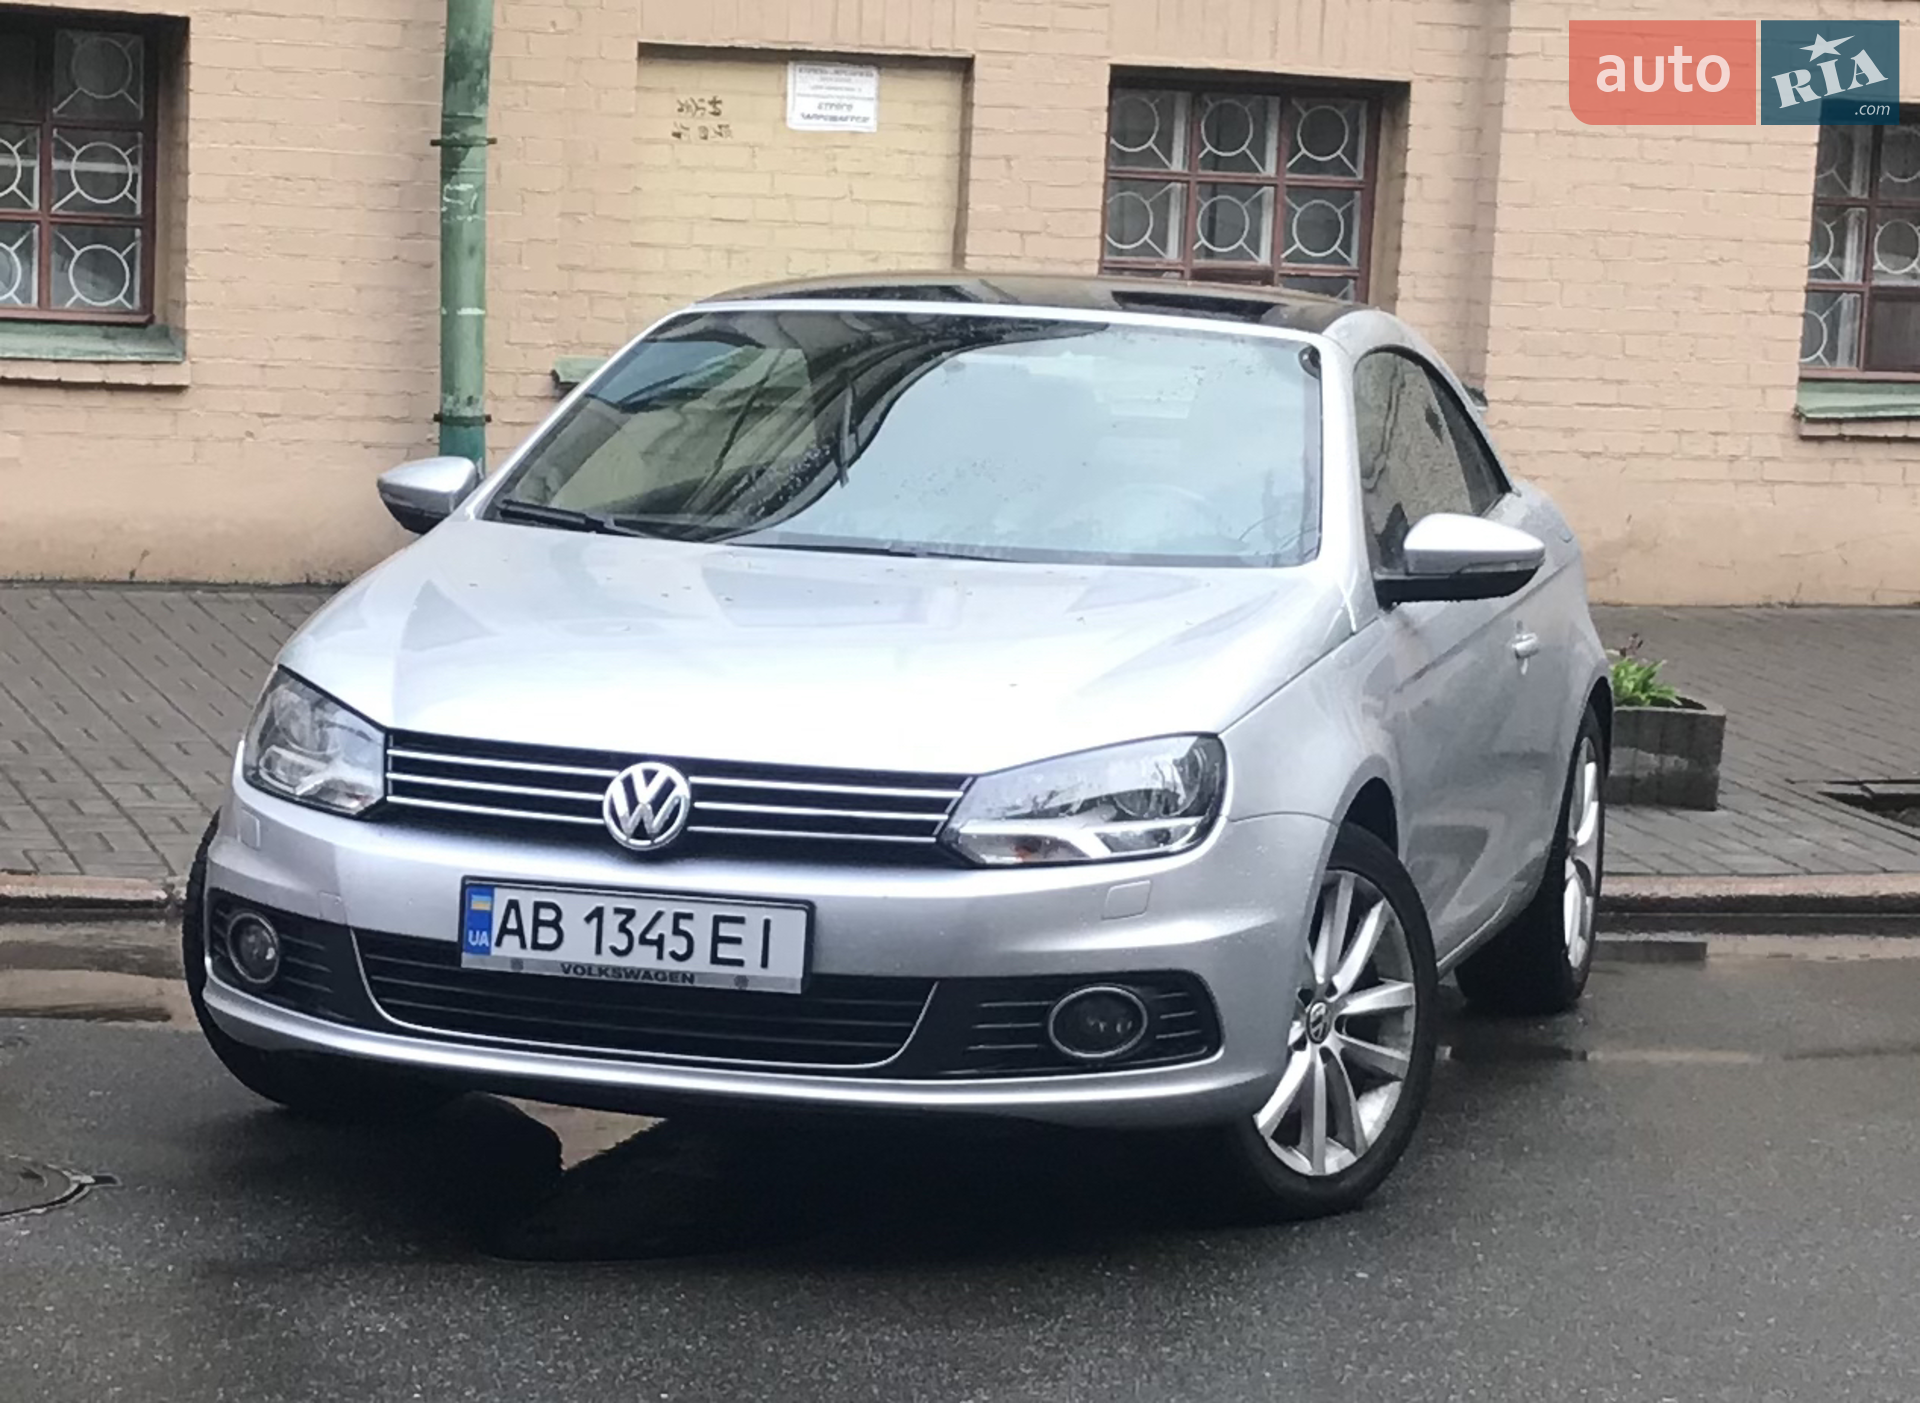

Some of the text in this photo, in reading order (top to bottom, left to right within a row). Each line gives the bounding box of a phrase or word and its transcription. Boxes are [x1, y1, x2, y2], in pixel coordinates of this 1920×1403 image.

[468, 929, 489, 947] UA
[494, 898, 771, 969] AB 1345 EI
[560, 962, 696, 985] VOLKSWAGEN
